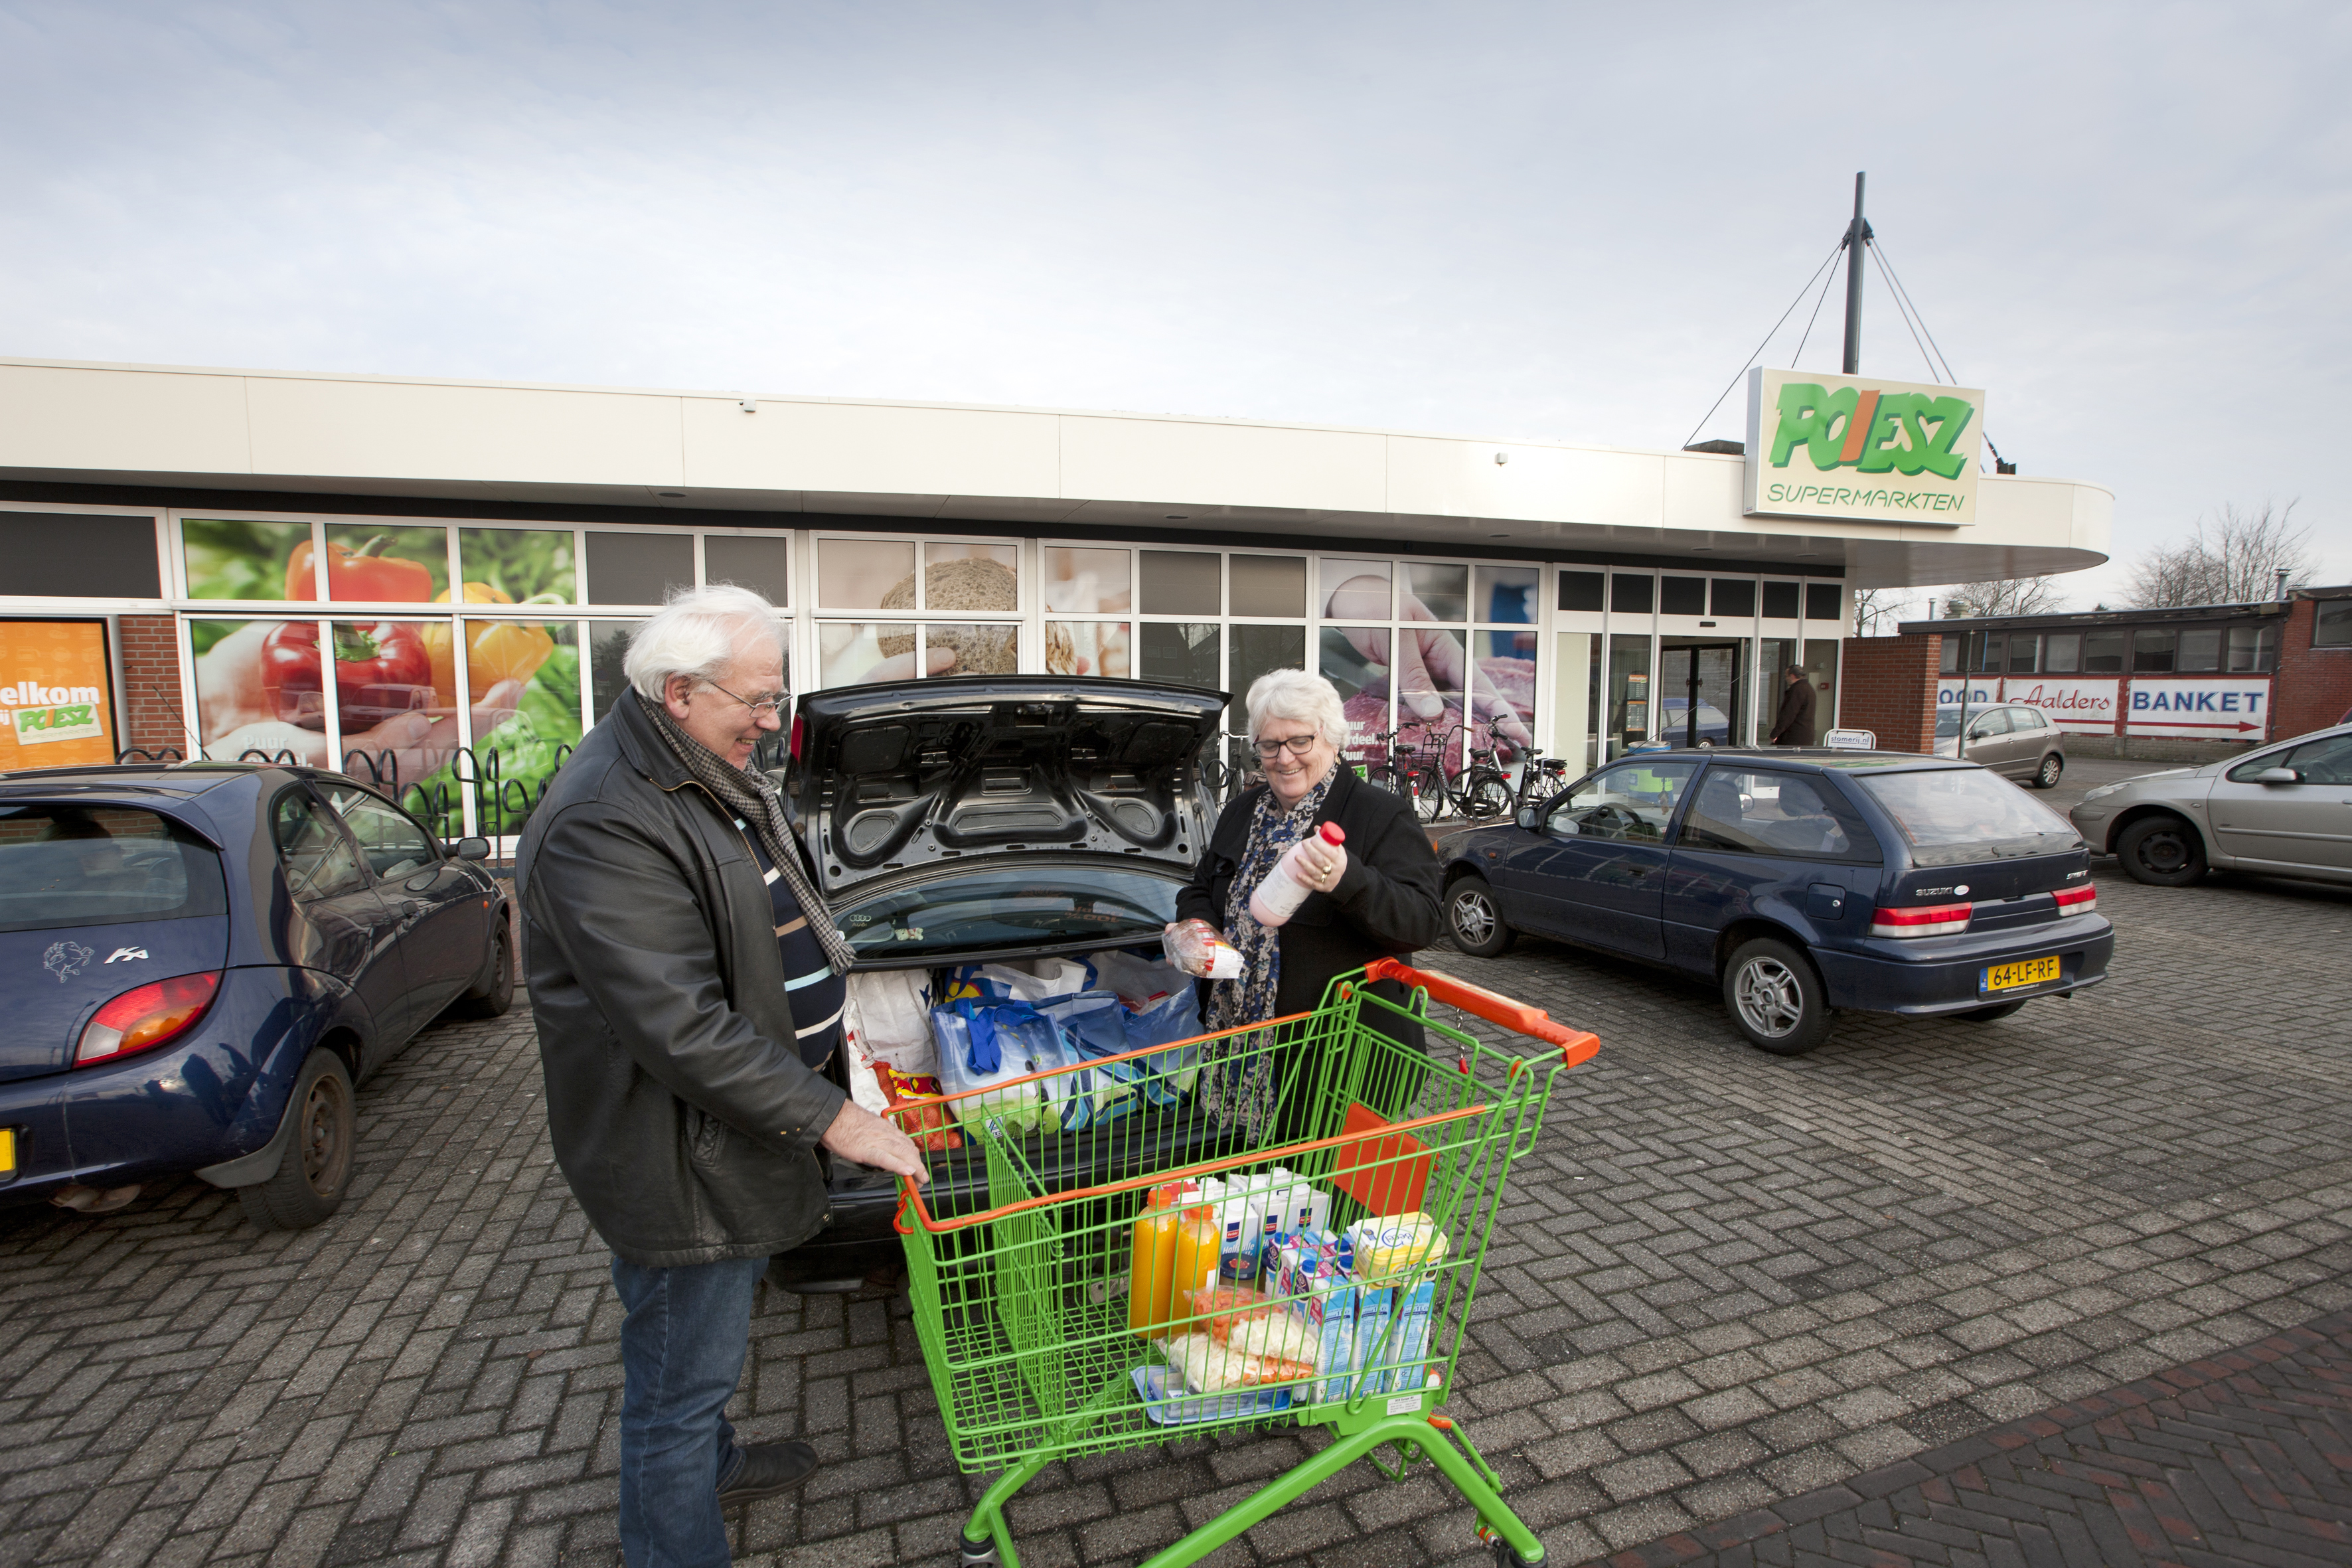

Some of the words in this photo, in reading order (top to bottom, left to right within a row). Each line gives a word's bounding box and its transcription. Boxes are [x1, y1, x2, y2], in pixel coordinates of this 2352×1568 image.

[1768, 383, 1975, 480] POIESZ
[1767, 483, 1966, 511] SUPERMARKTEN
[0, 682, 100, 705] elkom
[2009, 684, 2114, 710] Aalders
[2132, 691, 2264, 714] BANKET
[19, 705, 93, 732] POIESZ
[21, 728, 98, 740] SUPERMARKTEN
[244, 734, 288, 750] Puur
[1831, 736, 1869, 744] stomerij.nl
[2066, 870, 2088, 880] SWIFT
[1916, 887, 1953, 897] SUZUKI
[1994, 959, 2055, 986] 64-LF-RF
